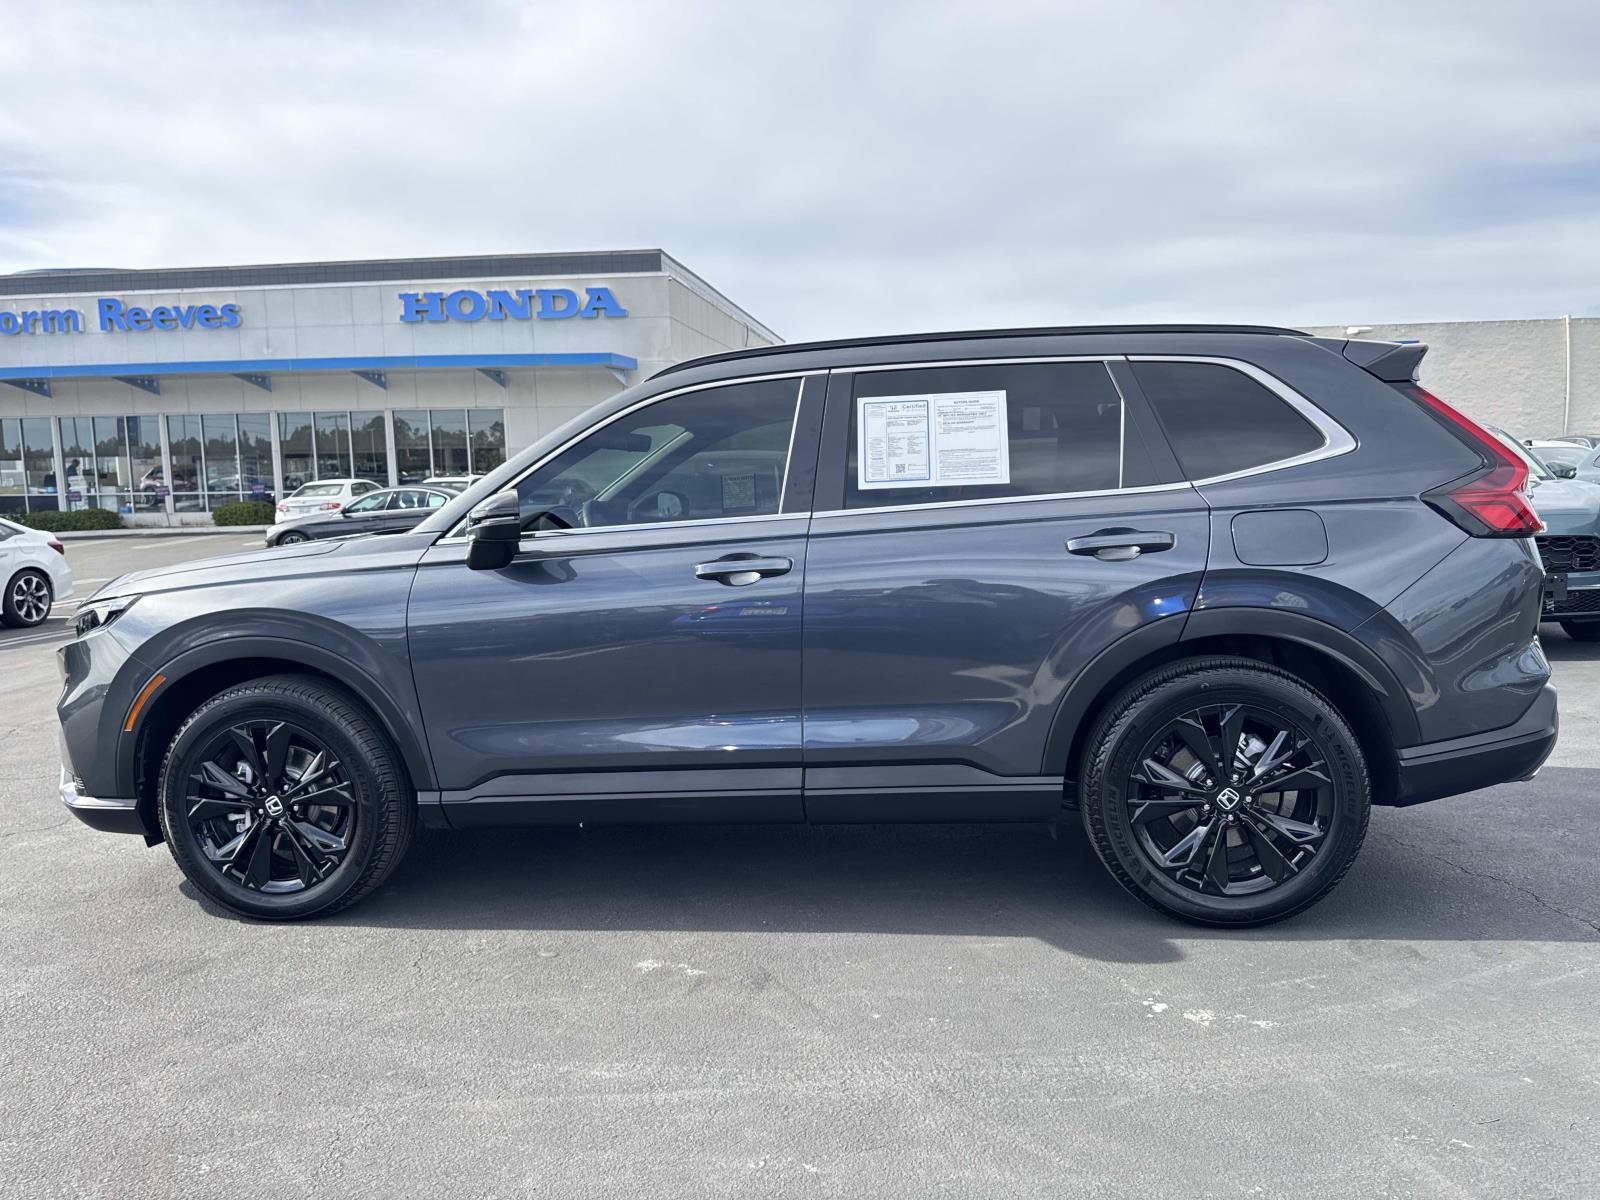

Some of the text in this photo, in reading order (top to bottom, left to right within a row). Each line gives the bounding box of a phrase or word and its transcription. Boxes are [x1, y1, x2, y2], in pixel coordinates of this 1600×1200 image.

[97, 298, 241, 332] Reeves
[399, 287, 628, 322] HONDA
[1333, 743, 1355, 813] MICHELIN
